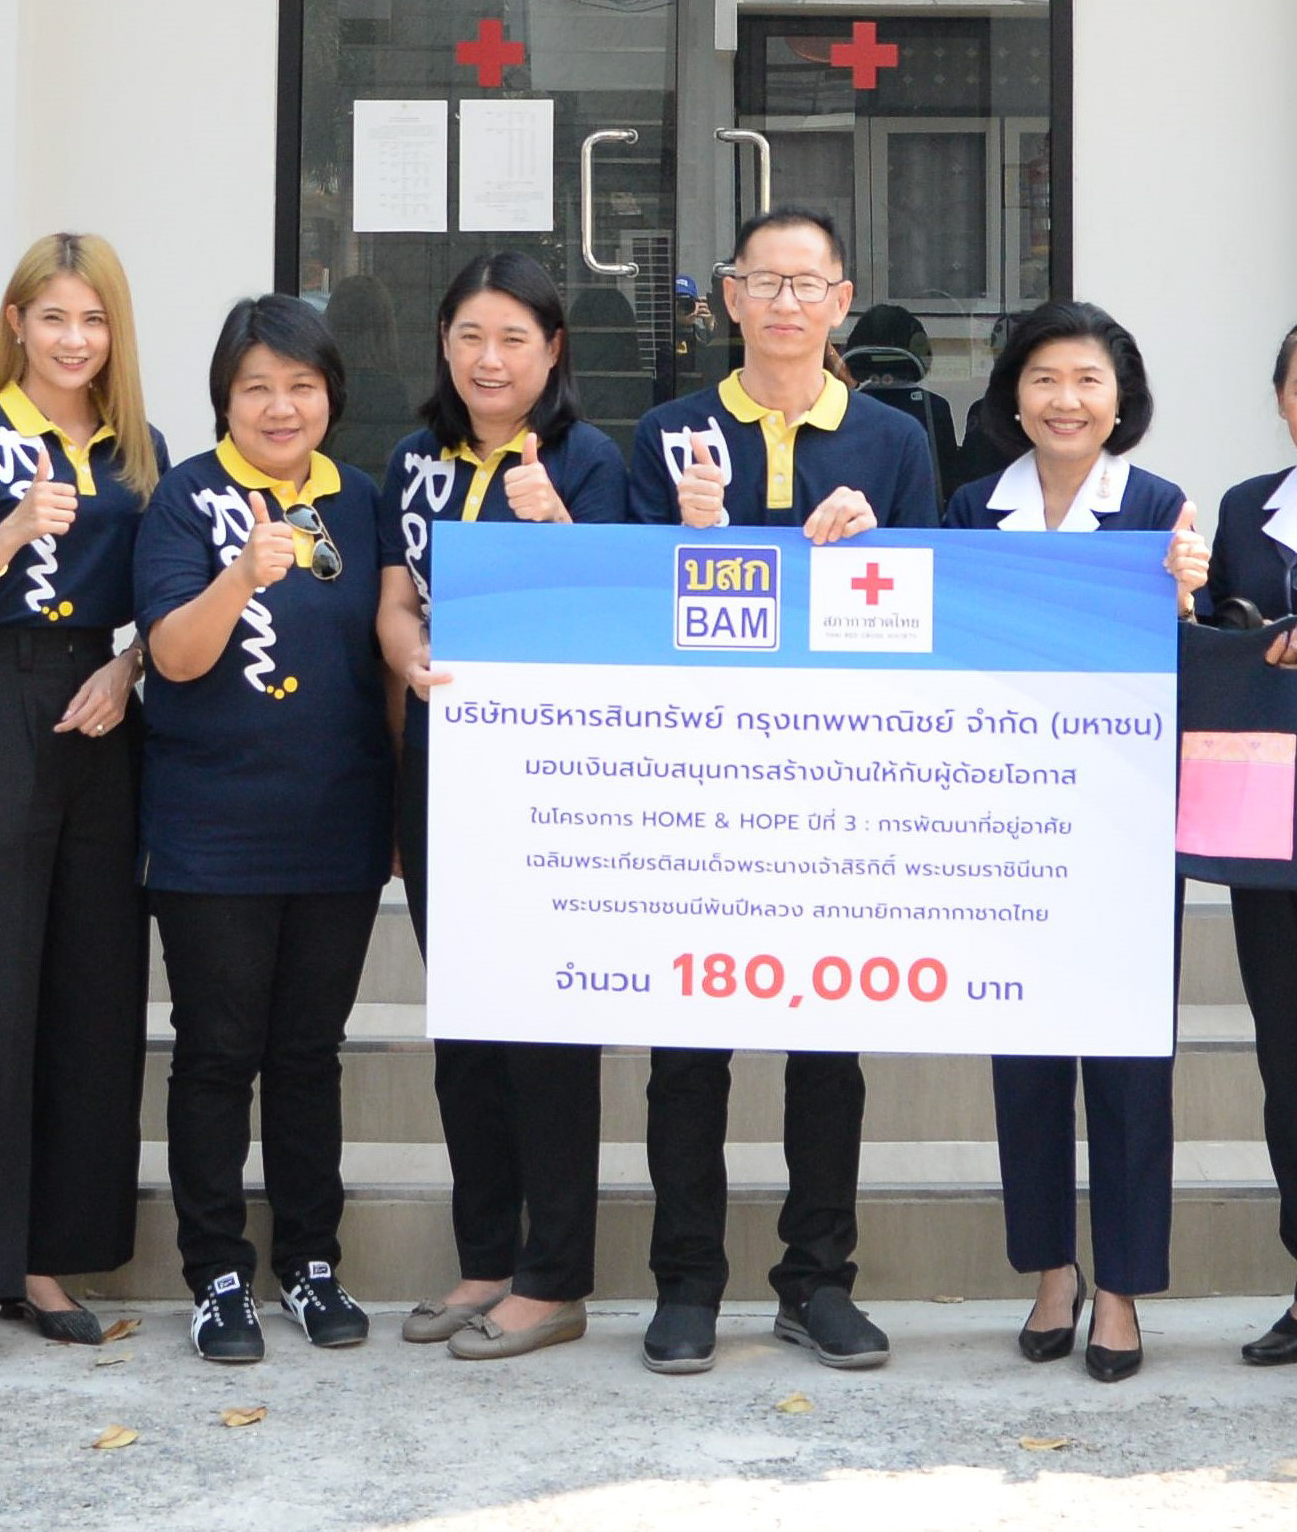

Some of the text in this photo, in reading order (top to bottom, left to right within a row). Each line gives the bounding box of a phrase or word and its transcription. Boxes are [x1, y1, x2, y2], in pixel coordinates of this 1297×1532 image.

[685, 557, 770, 592] บสก
[686, 606, 768, 639] BAM
[445, 700, 1163, 741] บริษัทบริหารสินทรัพย์ กรุงเทพพาณิชย์ จำกัด (มหาชน)
[525, 756, 1077, 791] มอบเงินสนับสนุนการสร้างบ้านให้กับผู้ด้อยโอกาส
[530, 807, 633, 827] ในโครงการ
[642, 811, 706, 828] HOME
[714, 812, 730, 829] &
[740, 813, 799, 830] HOPE
[808, 809, 836, 831] ปีที่
[844, 815, 856, 832] 3
[878, 812, 1072, 840] การพัฒนาที่อยู่อาศัย
[526, 852, 1068, 878] เฉลิมพระเกียรติสมเด็จพระนางเจ้าสิริกิติ์ พระบรมราชินีนาถ
[552, 897, 1049, 922] พระบรมราชชนนีพันปีหลวง สภานายิกาสภากาชาดไทย
[555, 953, 1023, 1009] จำนวน 180,000 บาท
